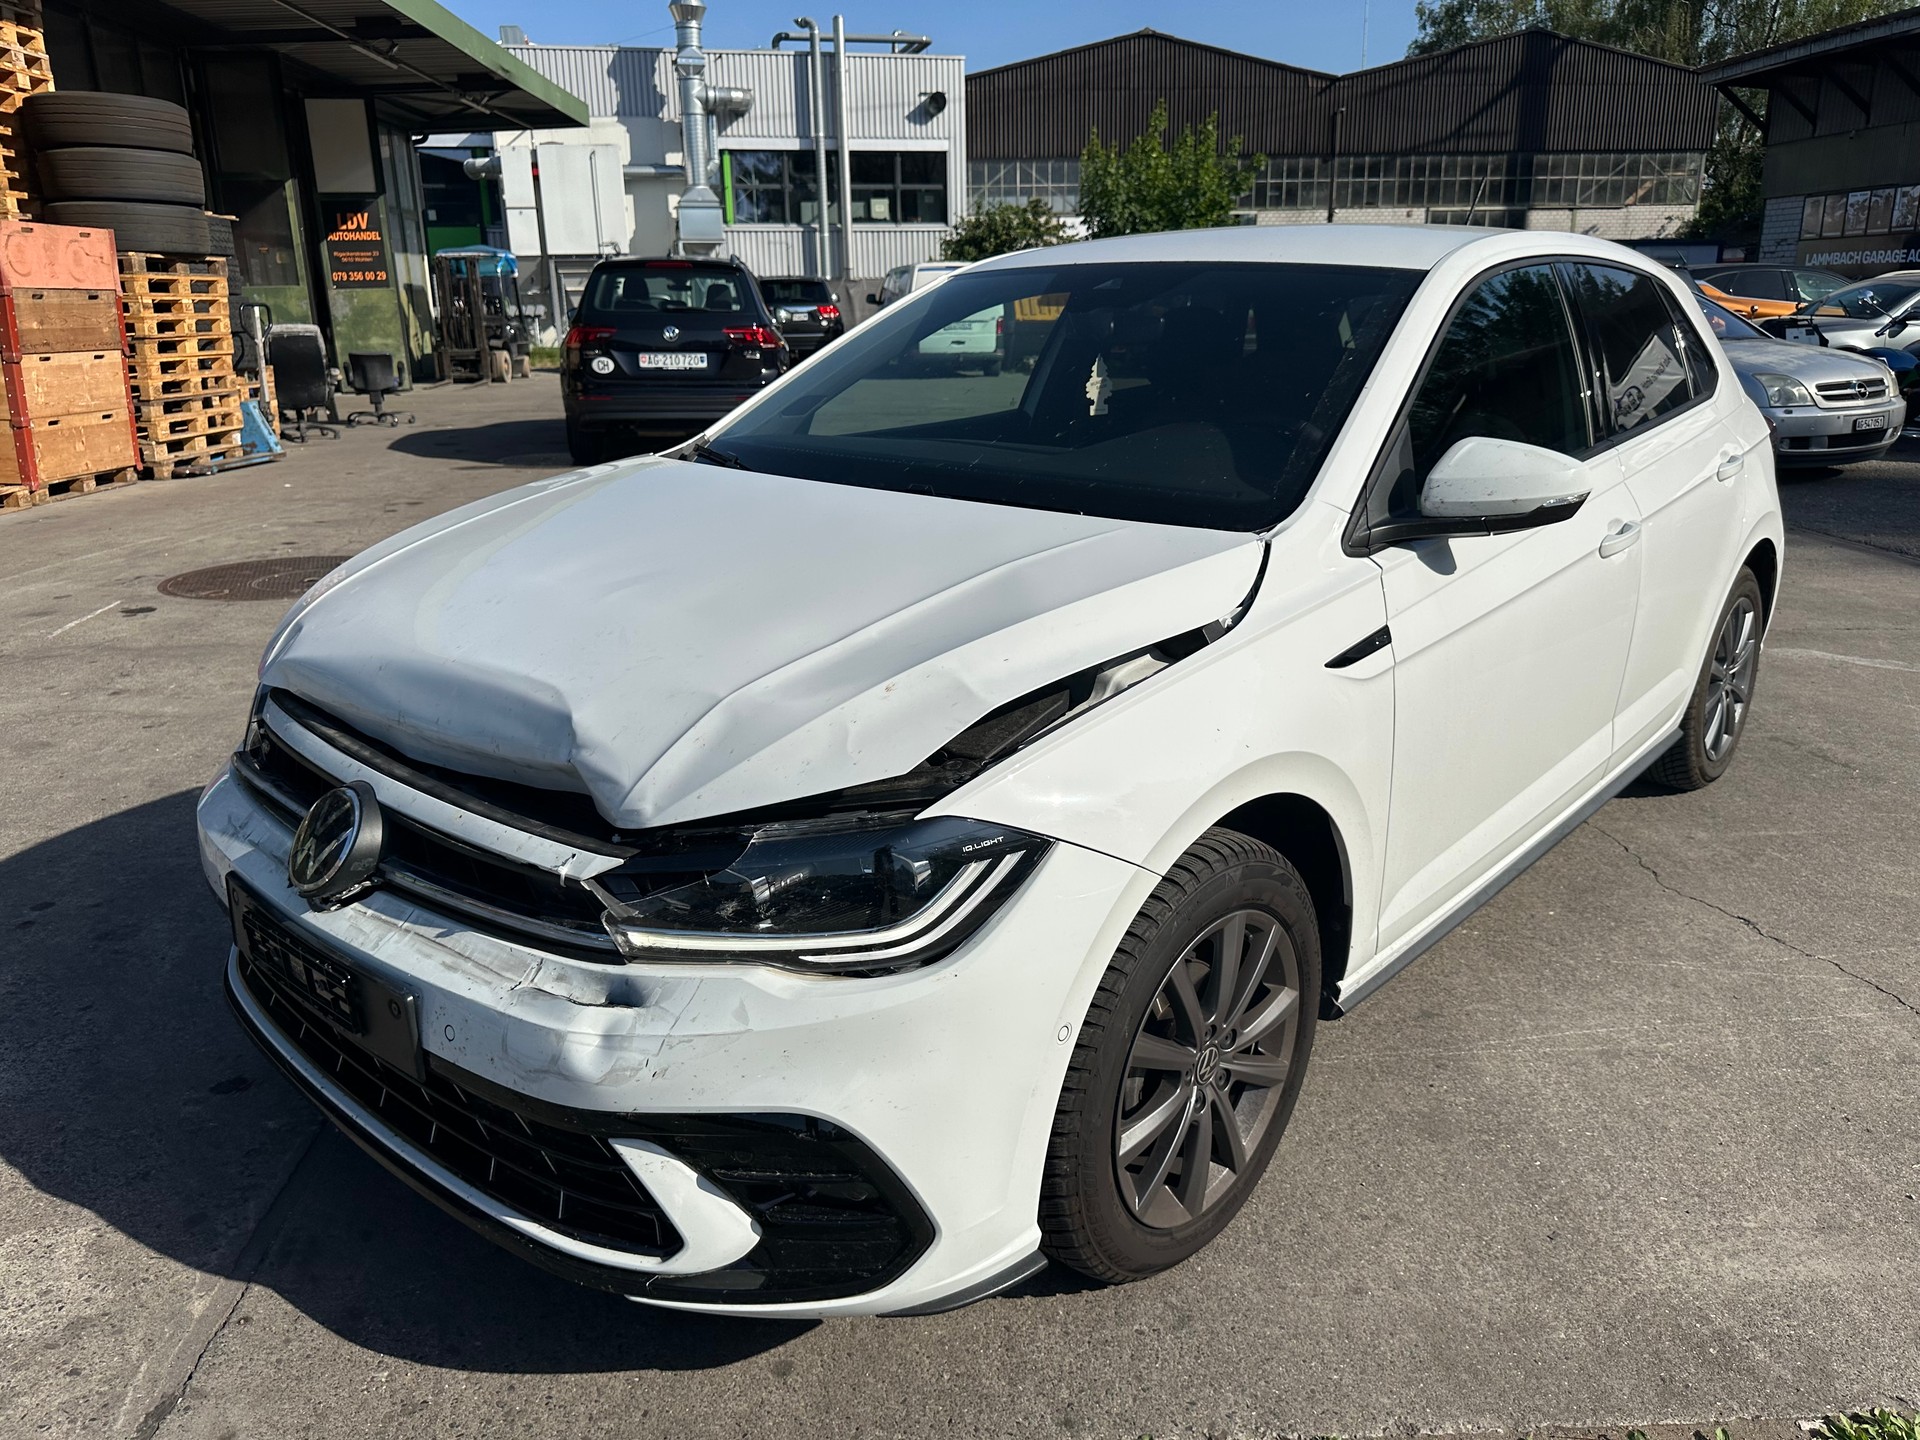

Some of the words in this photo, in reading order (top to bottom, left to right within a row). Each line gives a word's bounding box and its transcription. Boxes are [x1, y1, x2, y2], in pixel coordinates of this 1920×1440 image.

[336, 212, 369, 230] LDV
[327, 231, 382, 241] AUTOHANDEL
[1805, 251, 1862, 266] LAMMBACH
[1862, 249, 1907, 264] GARAGE
[332, 271, 348, 282] 079
[348, 271, 364, 281] 356
[364, 271, 375, 281] 00
[376, 270, 387, 280] 29
[597, 360, 610, 372] CH
[962, 836, 1004, 852] IQ.LIGHT
